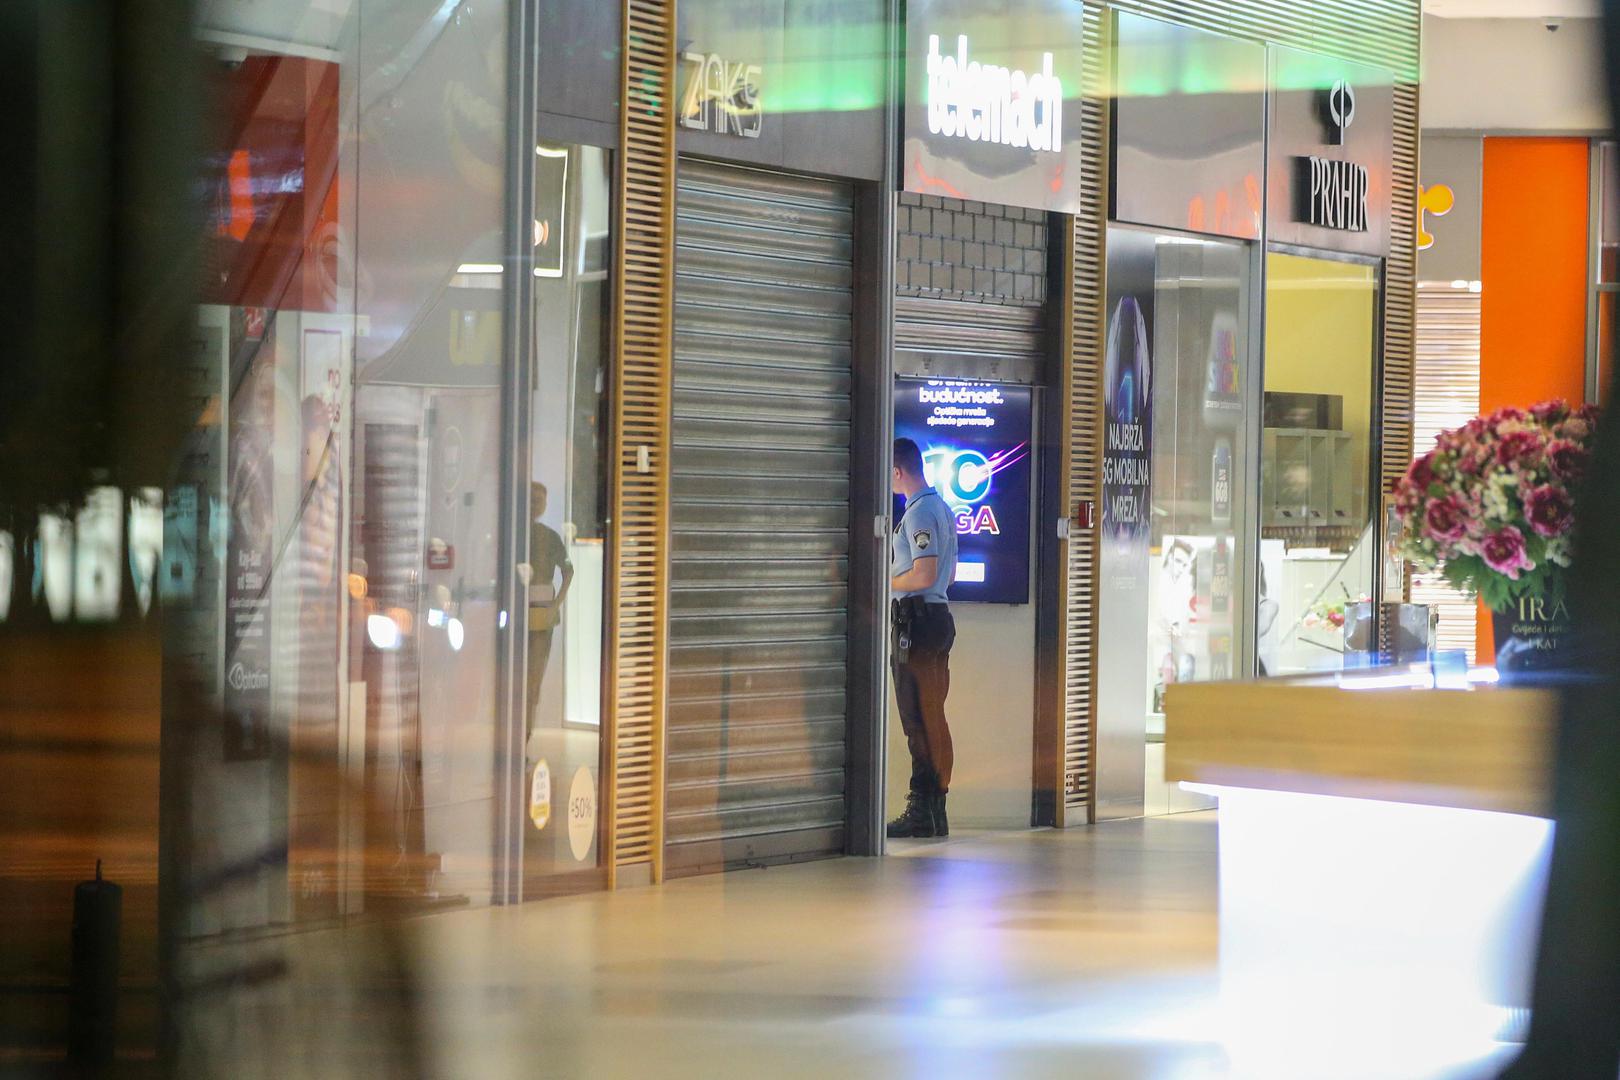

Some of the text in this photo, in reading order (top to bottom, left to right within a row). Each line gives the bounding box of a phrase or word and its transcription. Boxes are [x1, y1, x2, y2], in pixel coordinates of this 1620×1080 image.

[680, 52, 762, 138] ZAKS
[927, 34, 1062, 153] telemach
[1309, 155, 1369, 232] PRAHIR
[1109, 417, 1144, 451] NAJBRŽA
[1114, 457, 1150, 486] MOBILNA
[1112, 488, 1139, 523] MREŽA
